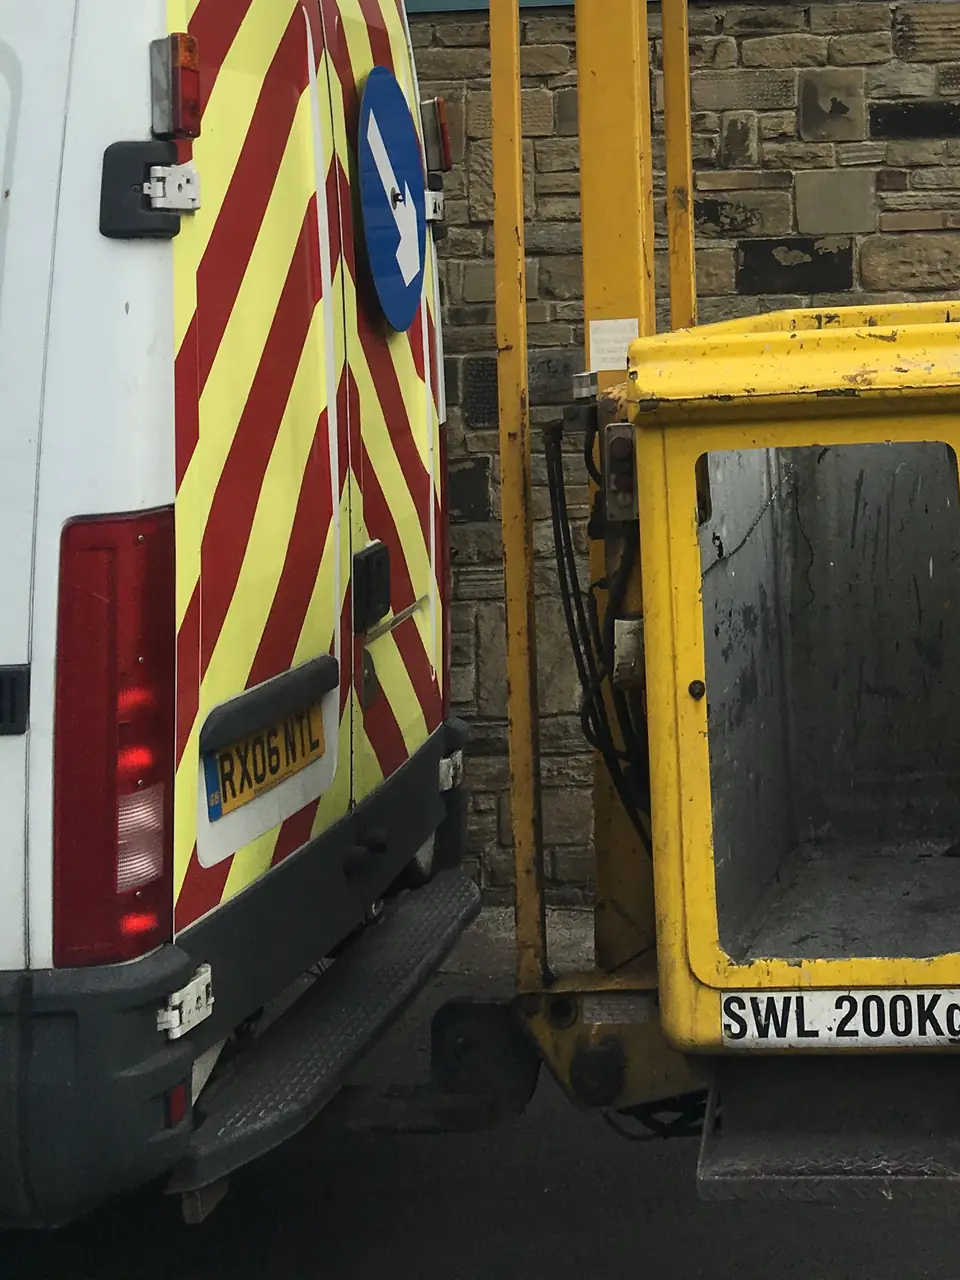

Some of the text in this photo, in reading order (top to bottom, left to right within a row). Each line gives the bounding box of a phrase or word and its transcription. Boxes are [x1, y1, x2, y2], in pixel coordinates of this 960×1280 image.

[218, 708, 320, 803] RX06 NTL
[723, 995, 820, 1040] SWL
